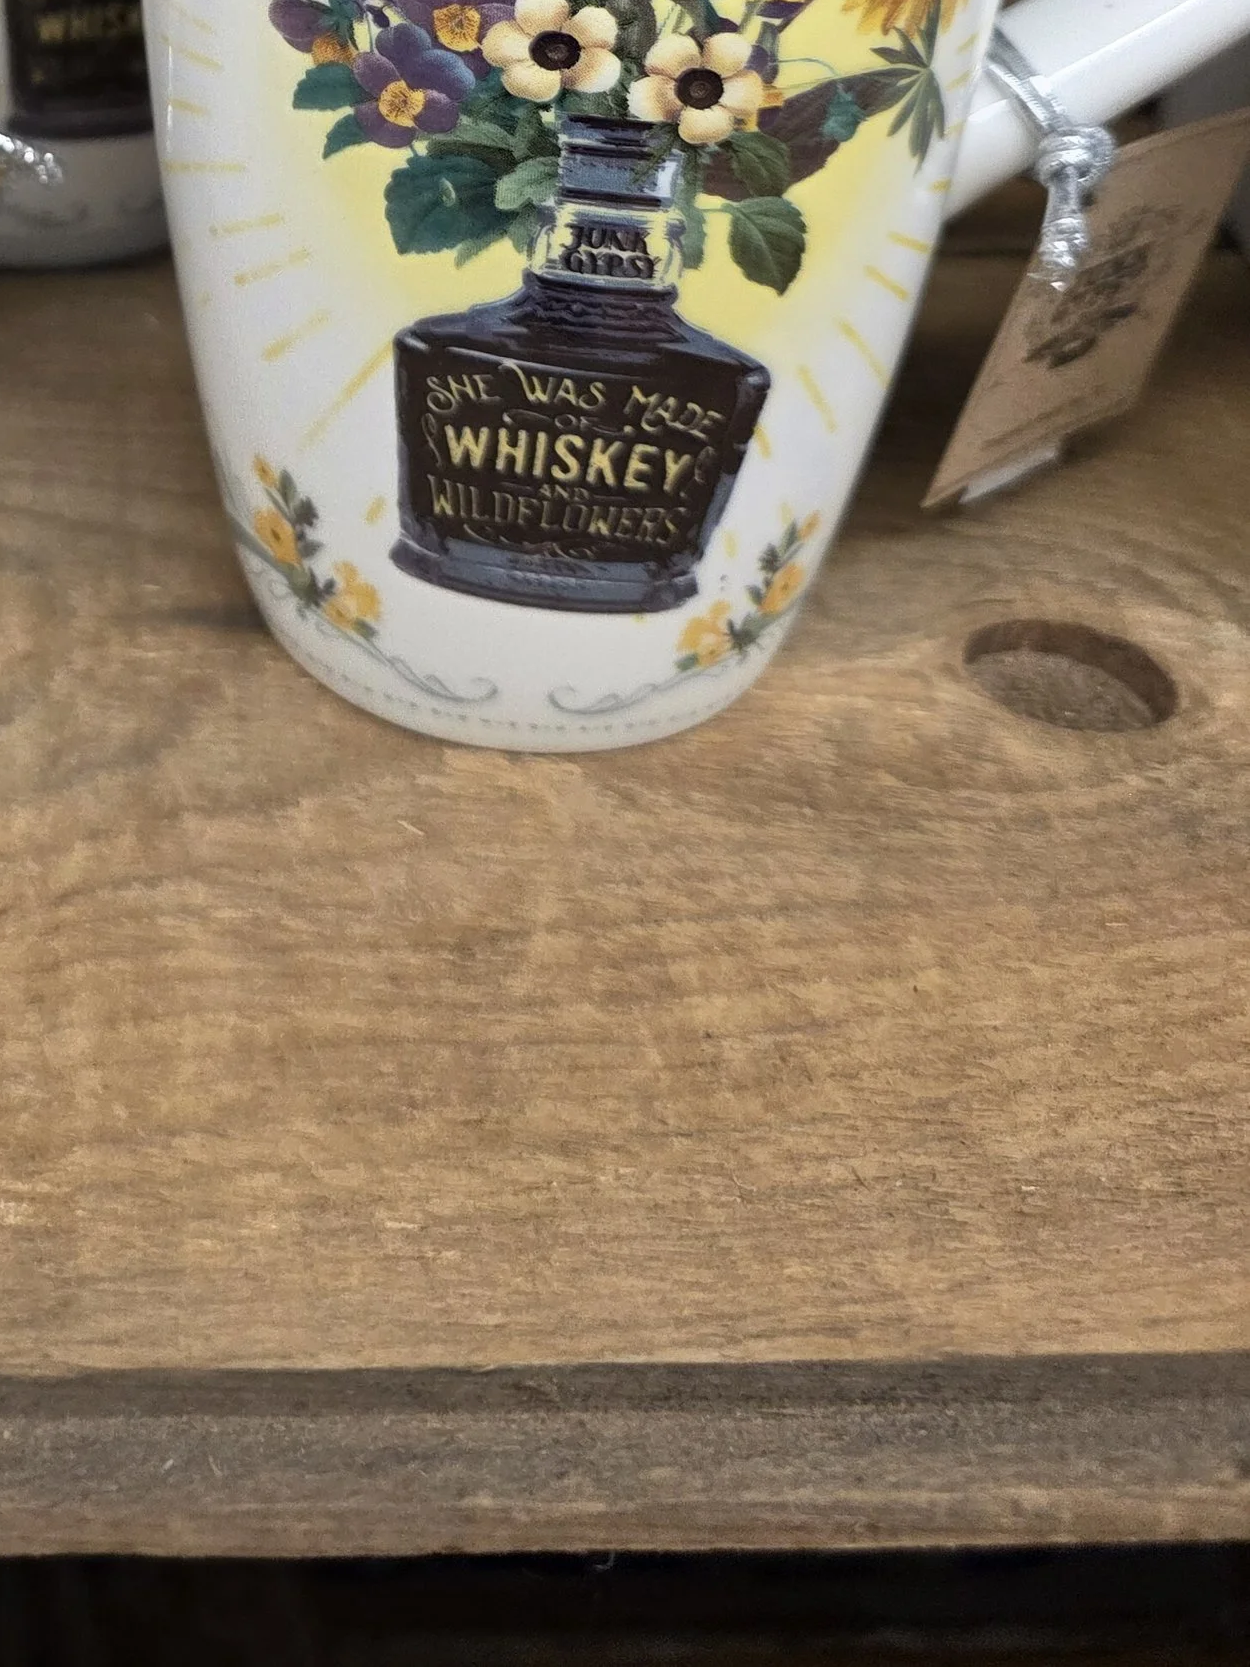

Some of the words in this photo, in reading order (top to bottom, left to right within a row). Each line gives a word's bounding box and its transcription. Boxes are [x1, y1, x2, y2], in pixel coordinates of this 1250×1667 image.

[564, 226, 650, 253] JUNK
[558, 248, 662, 278] GYPSY
[425, 374, 500, 414] SHE
[498, 362, 606, 408] WAS
[620, 385, 727, 441] MADE
[554, 414, 591, 431] OF
[445, 423, 693, 494] WHISKEY
[537, 484, 589, 500] AND
[428, 473, 688, 544] WILDFLOWERS
